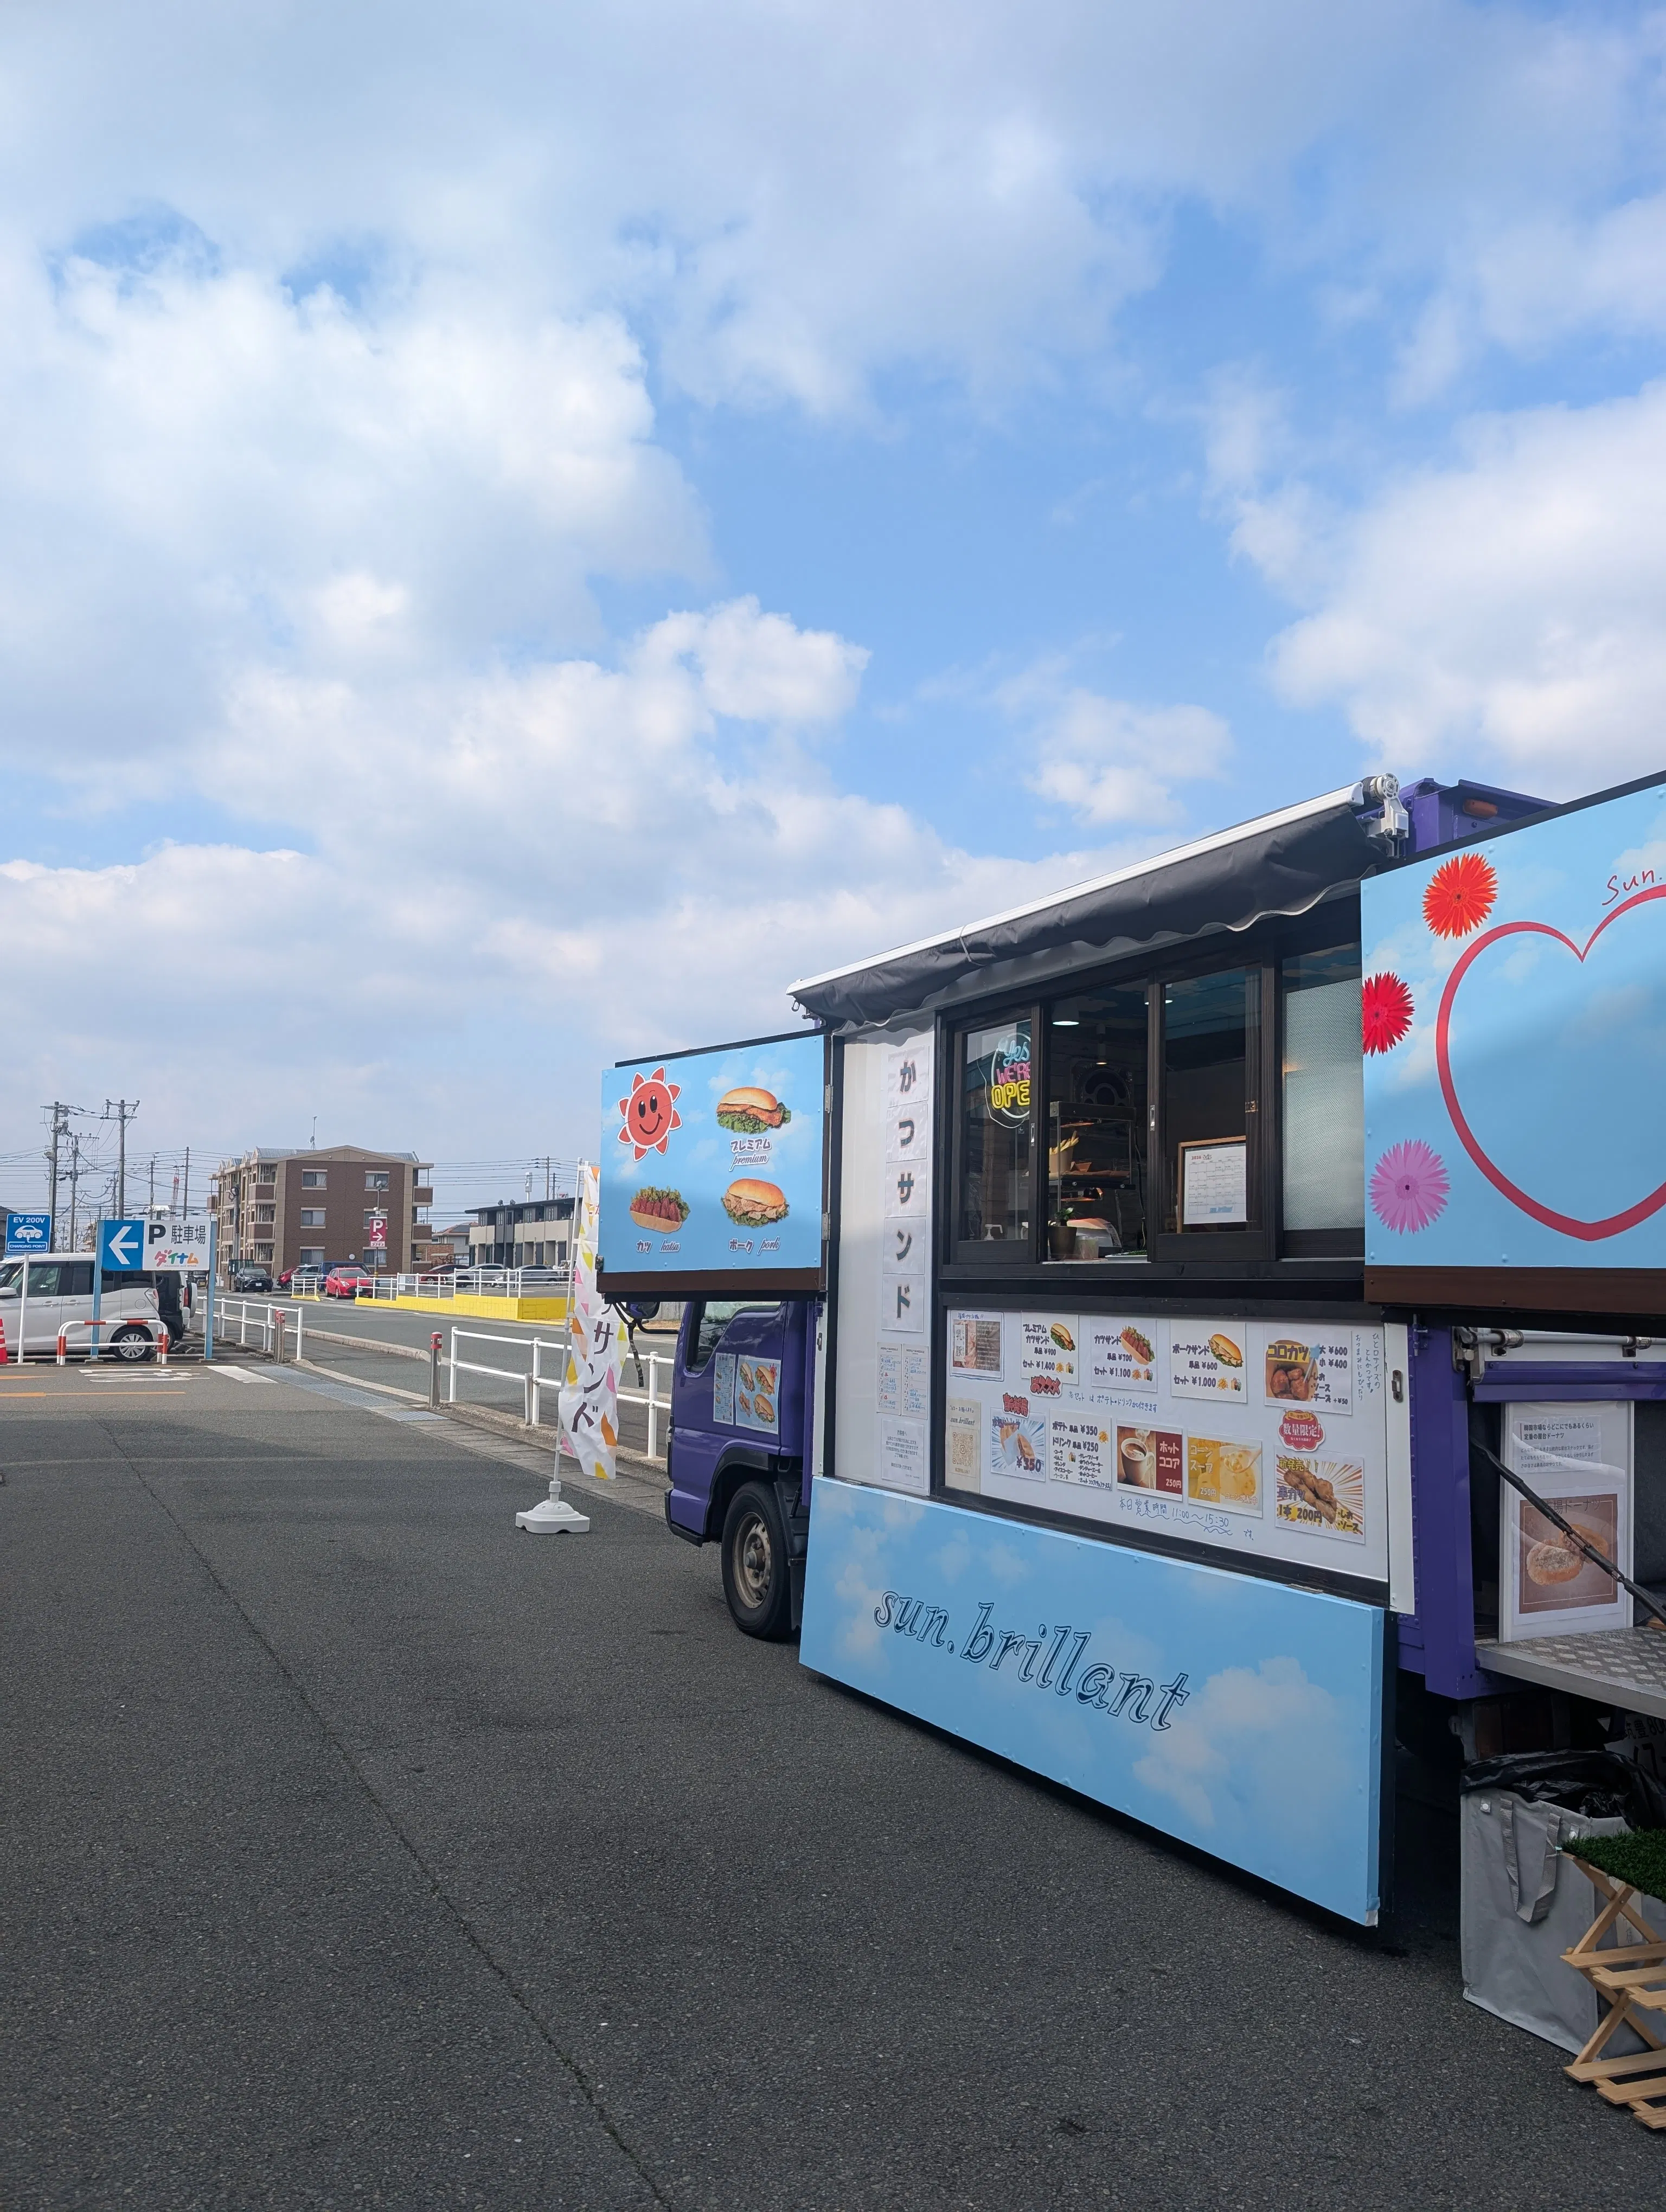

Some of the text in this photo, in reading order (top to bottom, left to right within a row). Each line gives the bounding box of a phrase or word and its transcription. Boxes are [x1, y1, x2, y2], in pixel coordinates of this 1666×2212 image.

[1601, 869, 1663, 905] Sun.
[1003, 1040, 1030, 1067] Yes
[730, 1137, 772, 1153] プレミアム
[729, 1154, 769, 1172] premium
[896, 1060, 917, 1319] かつサンド
[373, 1219, 383, 1232] P
[148, 1224, 166, 1245] P
[170, 1225, 207, 1245] 駐車場
[636, 1240, 652, 1253] カツ
[660, 1239, 681, 1253] katsu
[729, 1239, 754, 1253] ポーク
[758, 1237, 780, 1255] pork
[153, 1249, 198, 1267] ダイナム
[1022, 1323, 1047, 1334] プレミアム
[1026, 1334, 1050, 1345] カツサンド
[1094, 1334, 1122, 1345] カツサンド
[1044, 1348, 1056, 1356] ¥900
[1172, 1343, 1210, 1356] ポークサンド
[1267, 1345, 1309, 1361] コロカツ
[1319, 1346, 1348, 1356] 大 ¥600
[1022, 1359, 1034, 1368] セット
[1107, 1353, 1132, 1362] 単品 ¥700
[1319, 1358, 1348, 1369] 小 ¥400
[1094, 1366, 1107, 1376] セット
[1188, 1360, 1218, 1371] 単品 ¥600
[1174, 1374, 1189, 1385] セット
[1089, 1394, 1094, 1403] は
[1052, 1420, 1098, 1436] ポテト 単品 ¥350
[1283, 1423, 1321, 1438] 数量限定!
[1523, 1422, 1594, 1431] 韓国市場ならどこにでもあるくらい
[1524, 1432, 1565, 1441] 定番の屋台ドーナツ
[1052, 1436, 1099, 1453] ドリンク 単品 ¥250
[1159, 1441, 1180, 1454] ホット
[1190, 1444, 1213, 1457] コーン
[1016, 1456, 1042, 1472] ¥350
[1159, 1456, 1180, 1469] ココア
[1190, 1459, 1213, 1474] スープ
[1165, 1478, 1182, 1489] 250円
[1200, 1487, 1216, 1497] 250円
[1278, 1486, 1306, 1502] 串カツ
[1119, 1496, 1167, 1514] 本日営業時間
[1279, 1504, 1323, 1523] 1本 200円
[874, 1590, 1191, 1732] sun.brillant
